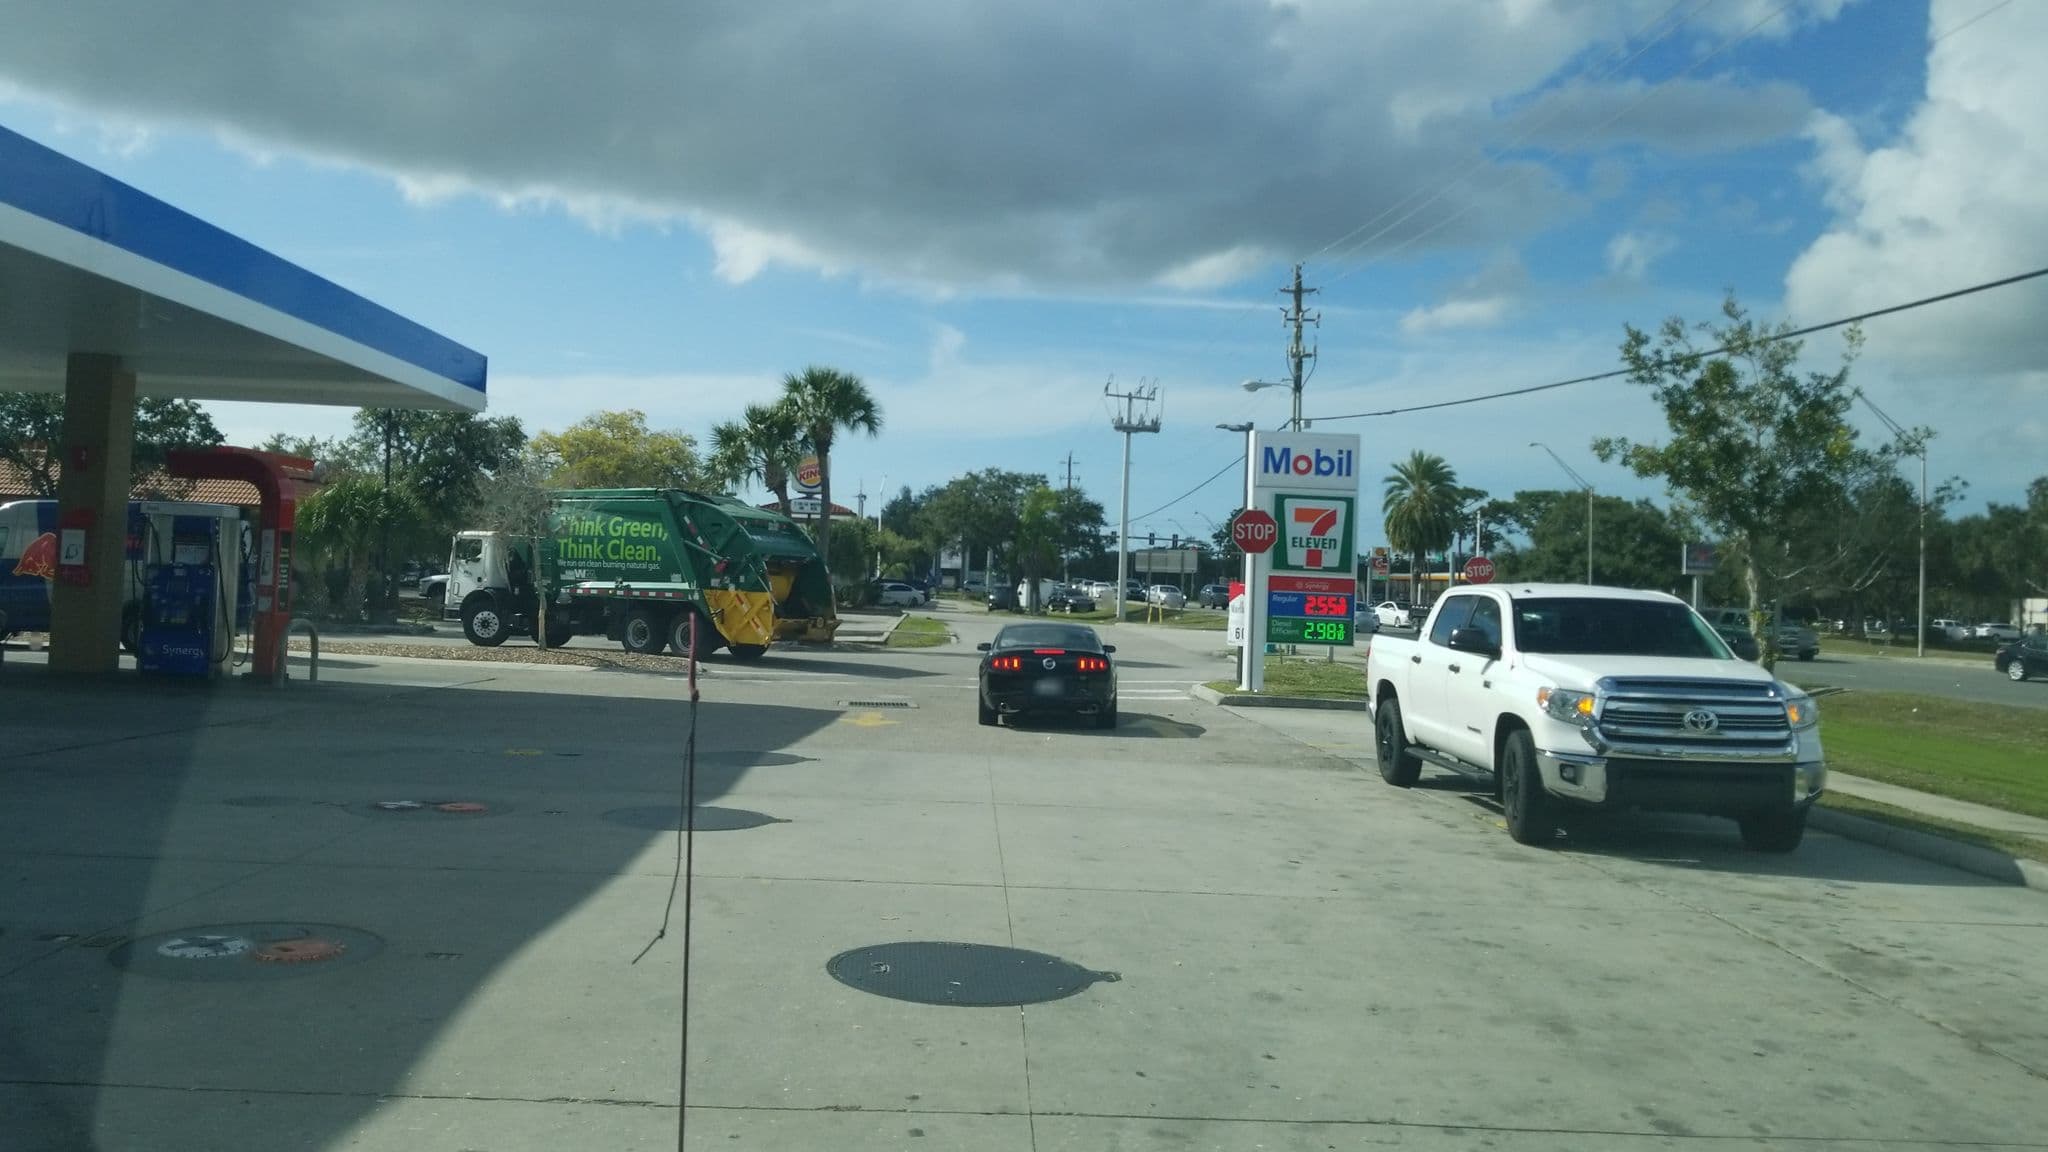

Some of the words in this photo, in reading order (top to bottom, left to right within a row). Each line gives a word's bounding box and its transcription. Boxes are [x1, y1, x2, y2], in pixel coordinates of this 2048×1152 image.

[1263, 446, 1352, 477] Mobil
[608, 516, 669, 541] Green,
[1235, 523, 1275, 540] STOP
[1294, 507, 1337, 568] 7
[558, 537, 604, 559] Think
[607, 539, 661, 561] Clean.
[586, 560, 602, 568] clean
[602, 560, 626, 570] burning
[1466, 565, 1493, 577] STOP
